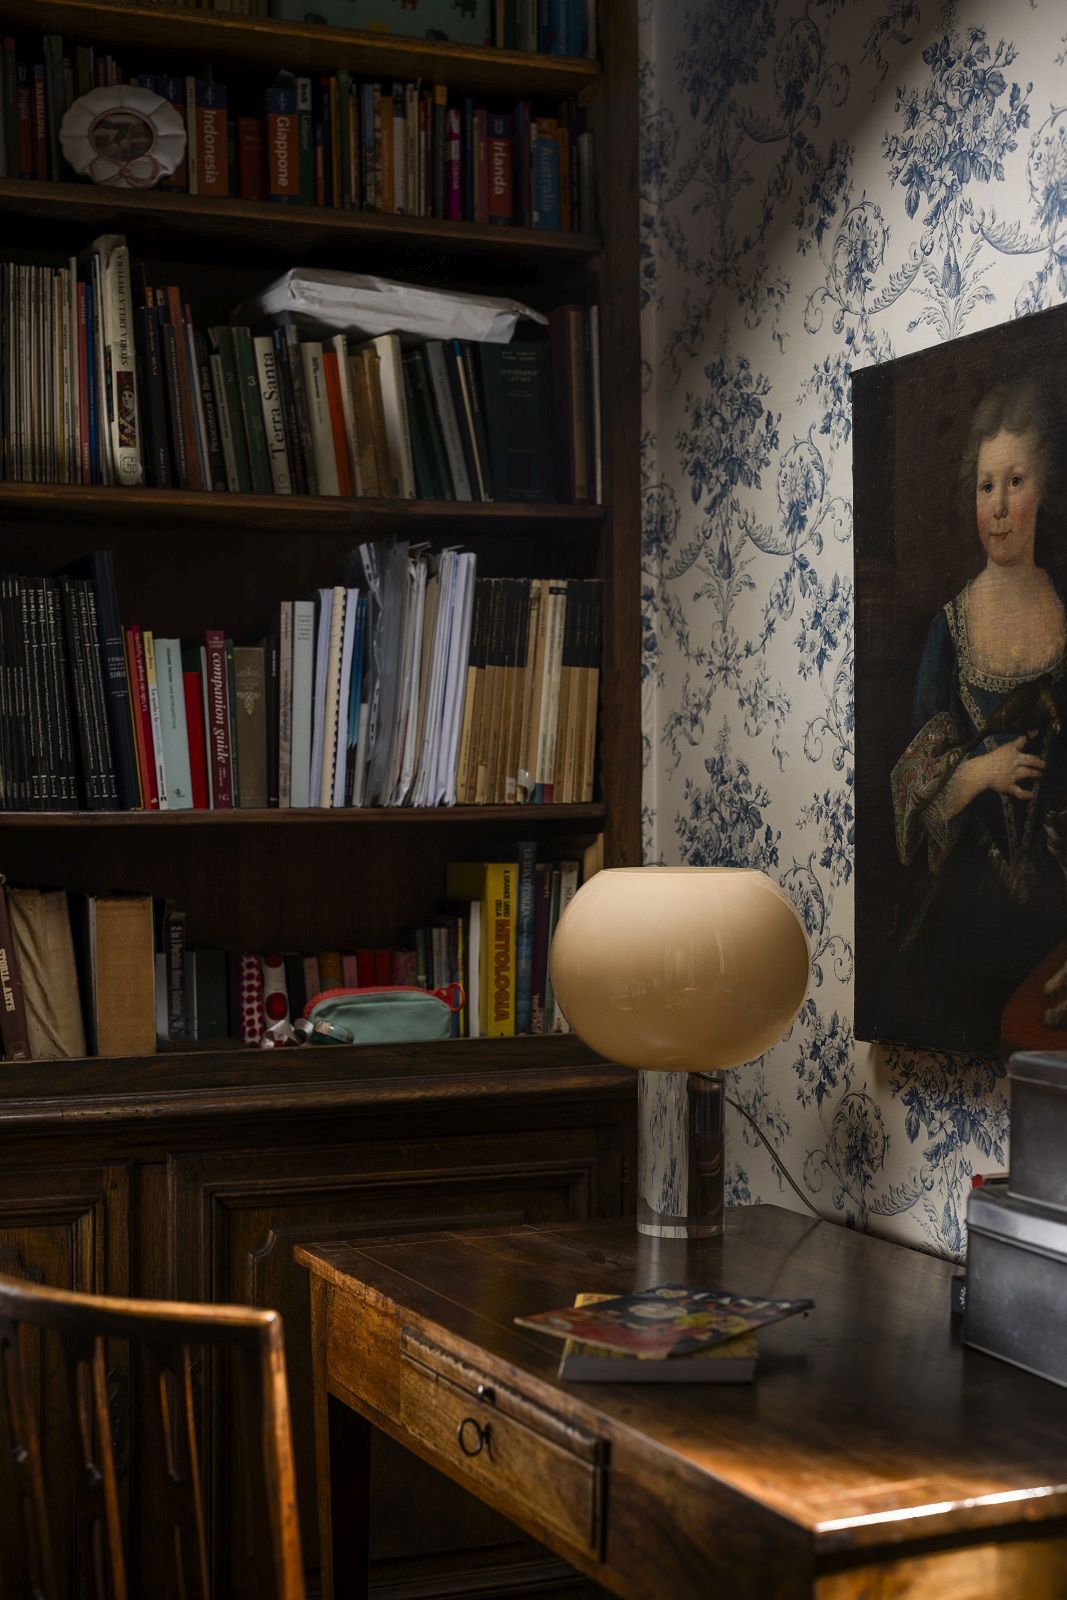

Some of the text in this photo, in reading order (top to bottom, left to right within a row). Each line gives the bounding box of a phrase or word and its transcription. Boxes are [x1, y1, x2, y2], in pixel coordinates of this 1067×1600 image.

[35, 82, 46, 139] BARCELLONA
[203, 110, 219, 184] Indonesia
[274, 116, 290, 187] Giappone
[494, 141, 506, 195] Irlanda
[540, 146, 554, 211] Australia
[116, 254, 129, 366] STORIA DELLA PITTURA
[201, 365, 219, 452] Pinacoteca di Brera
[263, 352, 279, 401] Santa
[269, 407, 286, 459] Terra
[210, 652, 226, 724] companion
[213, 726, 229, 764] guide
[0, 948, 15, 1012] STORIA ARTE
[494, 919, 510, 1022] MITOLOGIA
